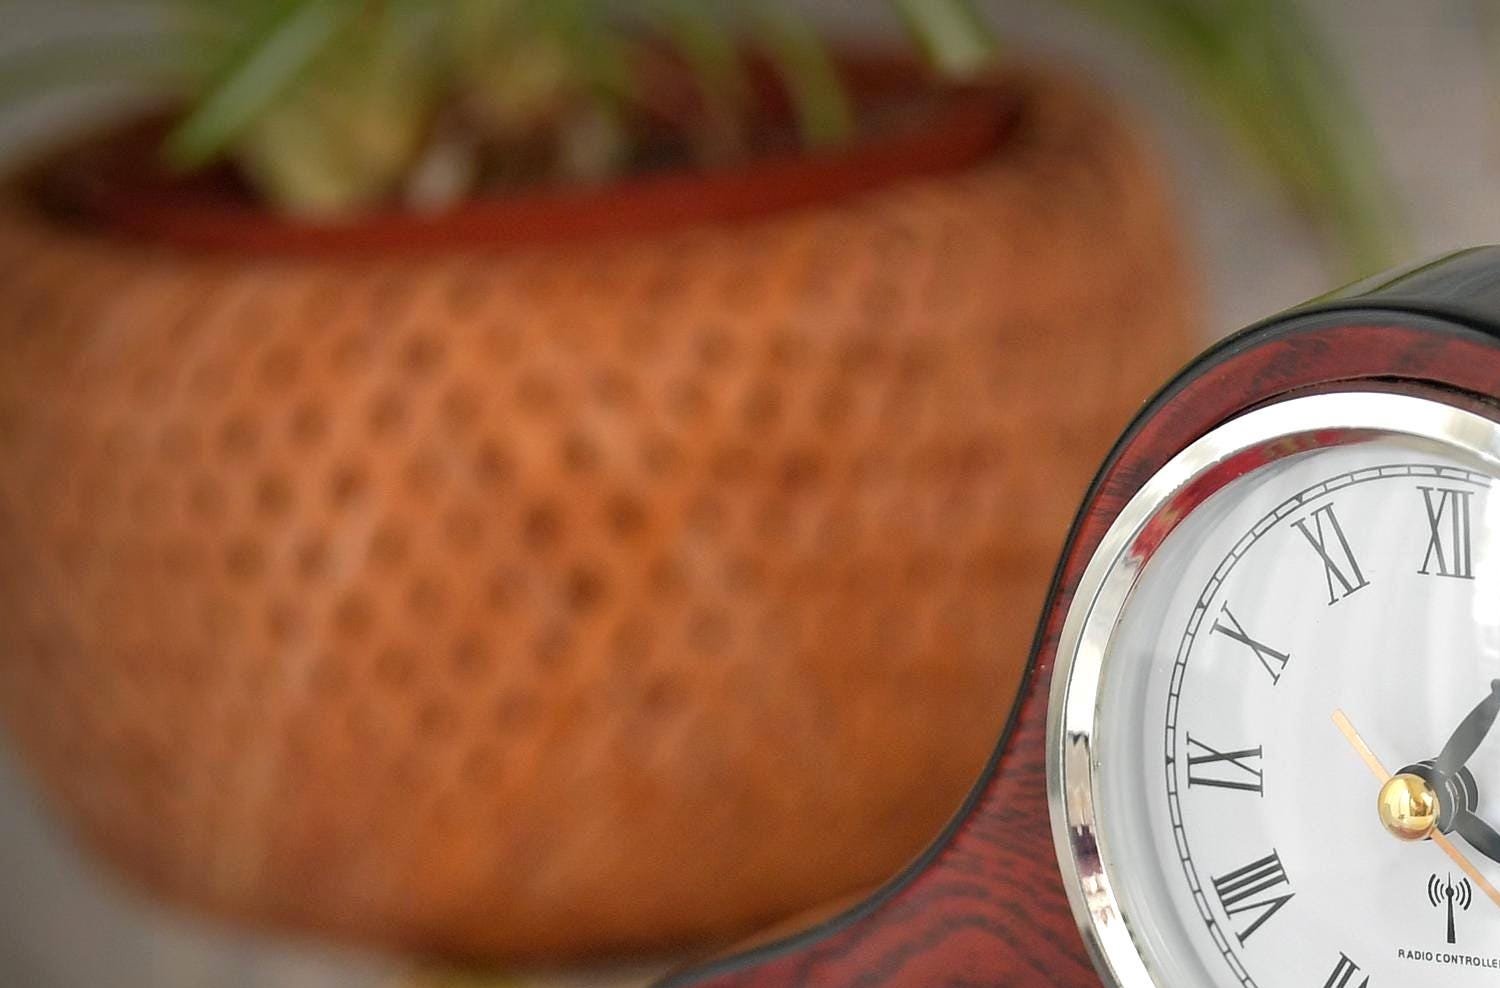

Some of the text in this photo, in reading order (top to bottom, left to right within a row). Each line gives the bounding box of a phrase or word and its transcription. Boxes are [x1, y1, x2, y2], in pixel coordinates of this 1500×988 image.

[1290, 502, 1370, 606] XI
[1416, 486, 1475, 580] XII
[1209, 600, 1290, 686] X
[1186, 731, 1264, 797] IX
[1210, 848, 1296, 948] VIII
[1398, 948, 1433, 961] RADIO
